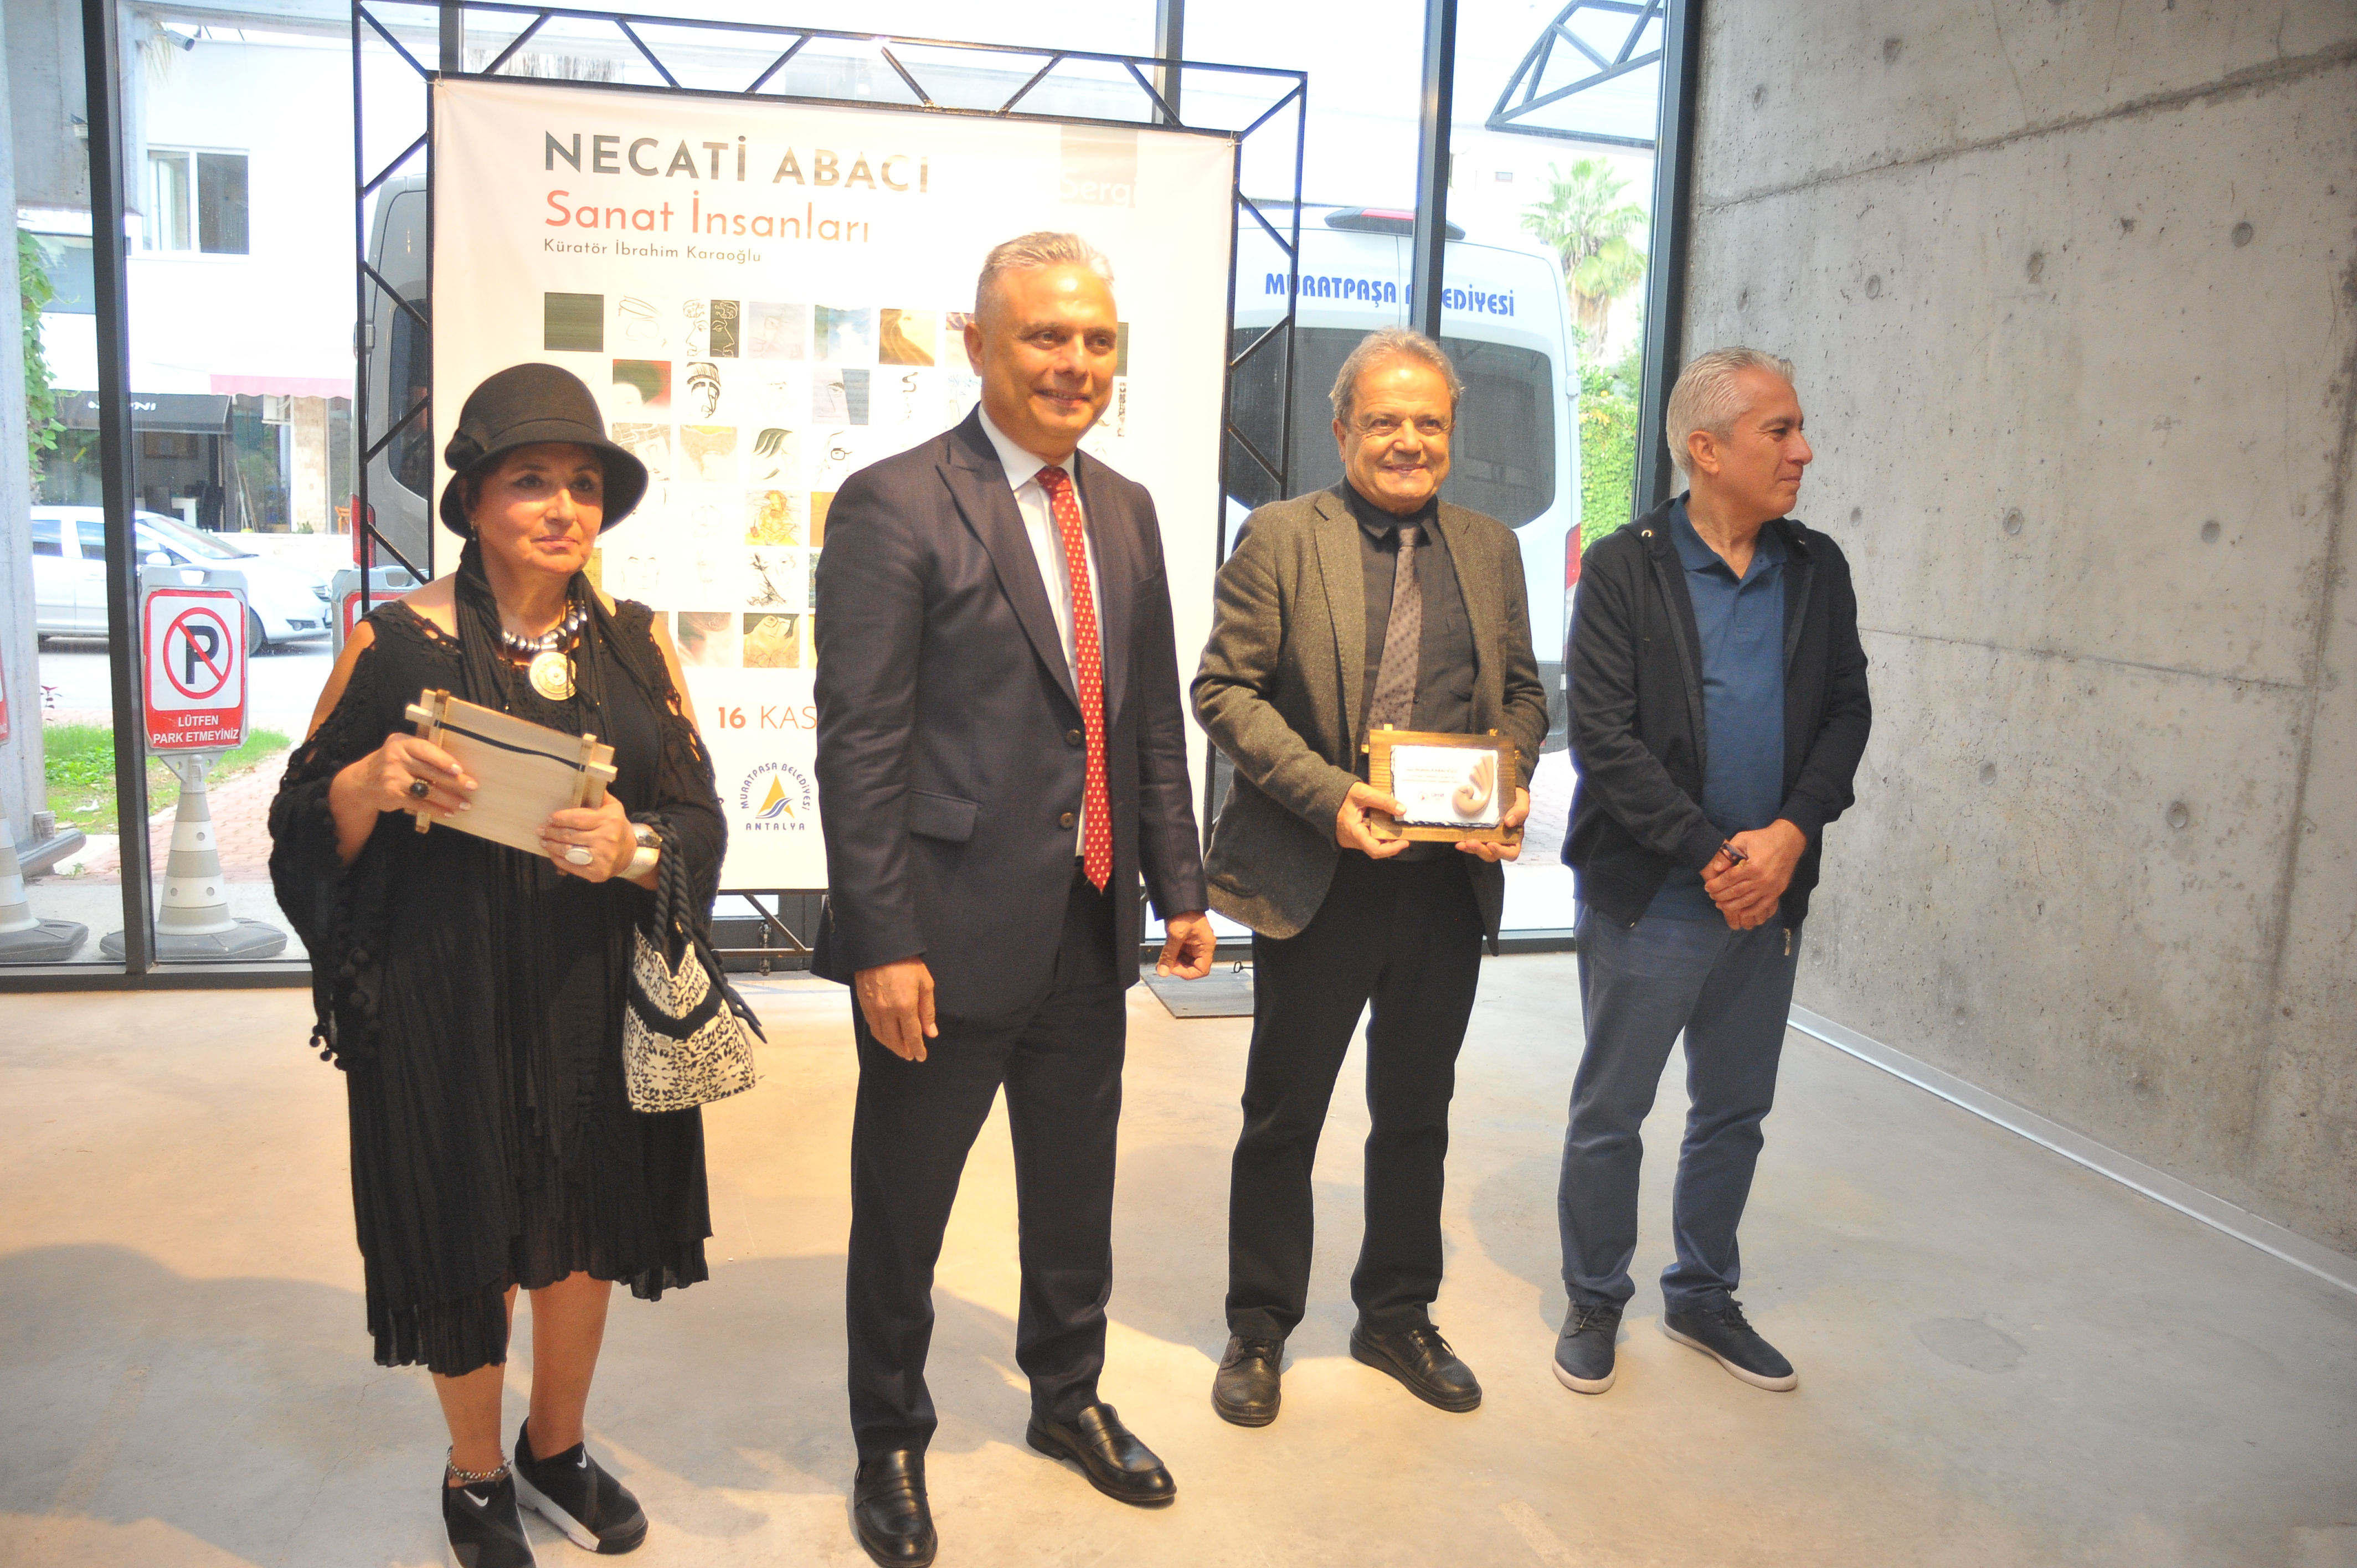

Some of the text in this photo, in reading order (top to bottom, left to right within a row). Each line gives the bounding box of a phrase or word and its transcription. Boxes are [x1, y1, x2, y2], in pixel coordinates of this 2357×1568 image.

[545, 130, 928, 193] NECATİ ABACI
[544, 190, 869, 243] Sanat İnsanları
[544, 238, 761, 265] Küratör İbrahim Karaoğlu
[1406, 283, 1514, 317] EDİYESİ
[178, 714, 219, 727] LÜTFEN
[718, 706, 747, 729] 16
[153, 728, 239, 744] PARK ETMEYİNİZ
[739, 762, 811, 811] MURATPAŞA BELEDİYESİ
